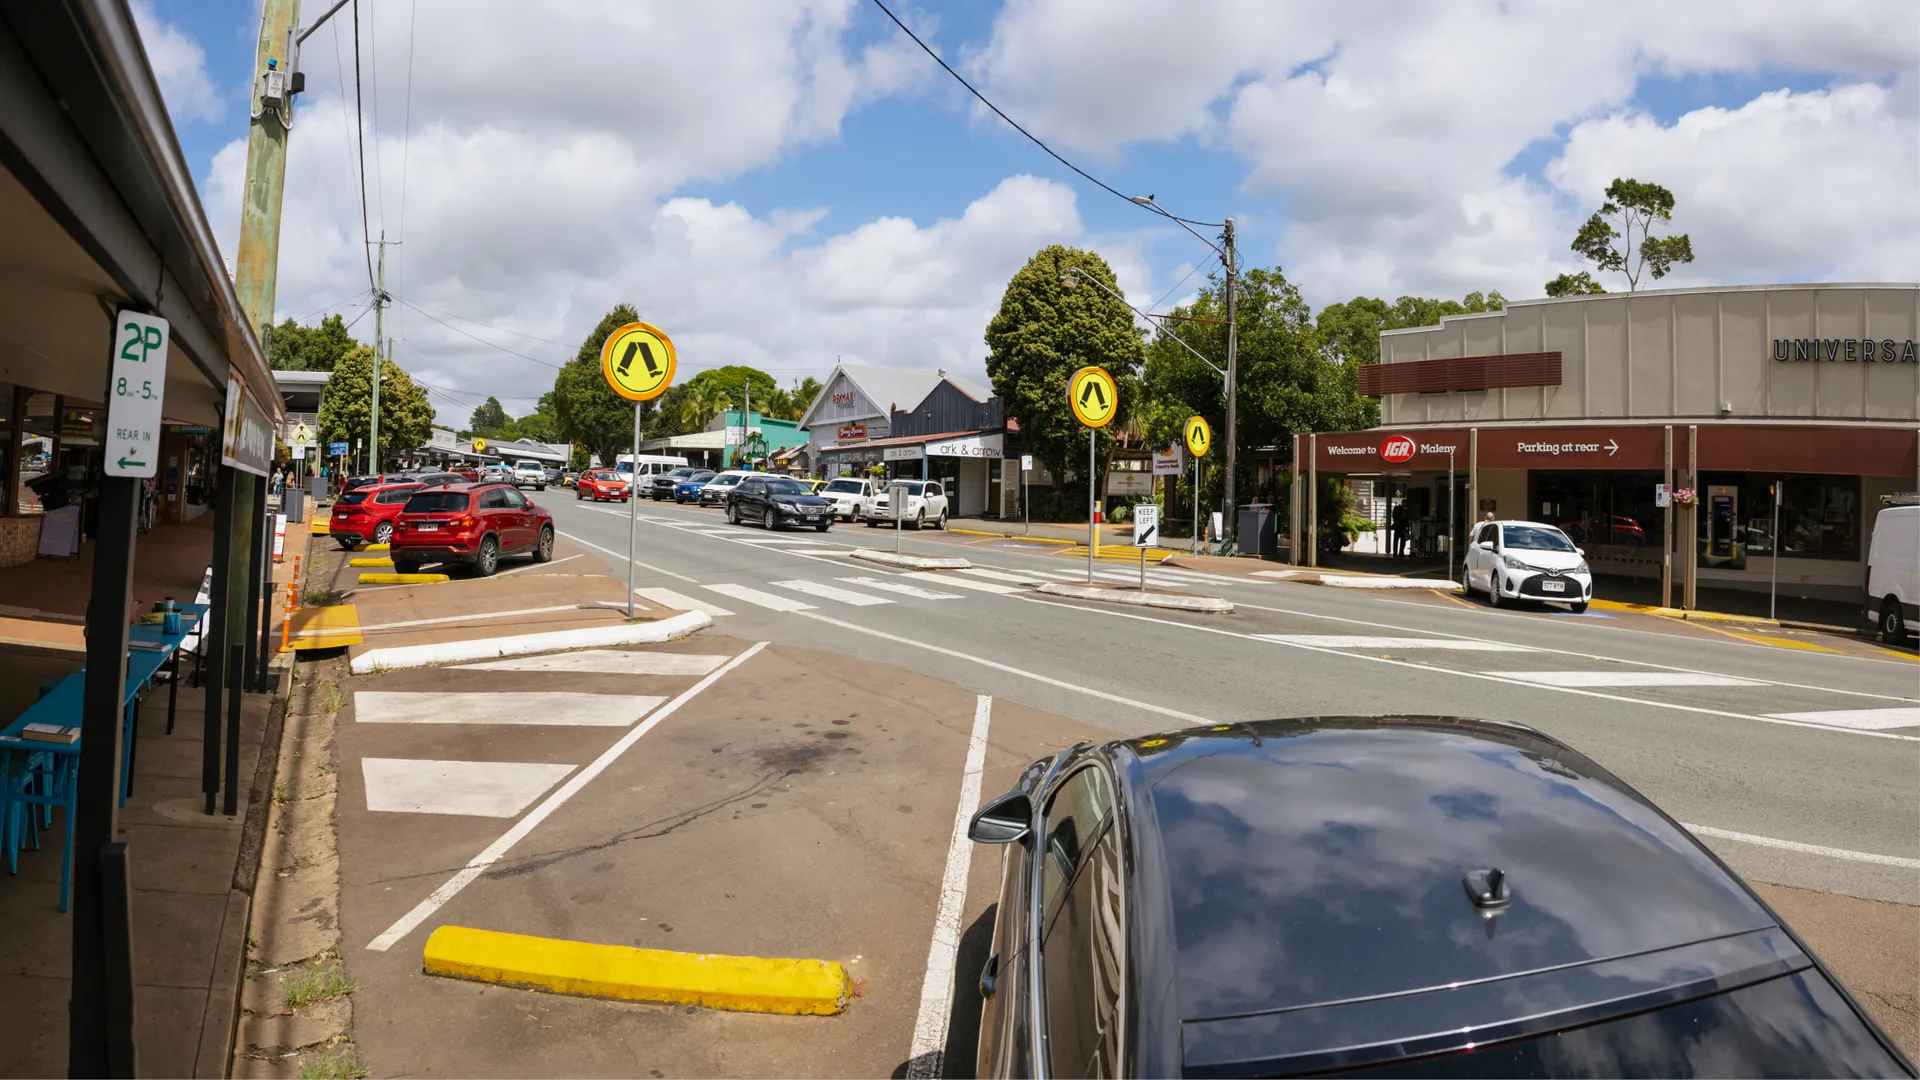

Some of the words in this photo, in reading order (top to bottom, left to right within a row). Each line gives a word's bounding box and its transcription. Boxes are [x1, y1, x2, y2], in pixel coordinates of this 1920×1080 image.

[121, 322, 162, 362] 2P
[1774, 339, 1917, 363] UNIVERSA
[116, 428, 139, 441] REAR
[142, 431, 151, 442] IN
[940, 443, 957, 454] ark
[961, 444, 969, 455] &
[972, 447, 1002, 457] arrow
[1328, 446, 1366, 455] Welcome
[1368, 446, 1376, 454] to
[1384, 441, 1410, 457] IGA
[1420, 444, 1456, 455] Maleny
[1517, 442, 1560, 455] Parking
[1561, 442, 1573, 452] at
[1575, 443, 1599, 452] rear
[1138, 508, 1154, 516] KEEP
